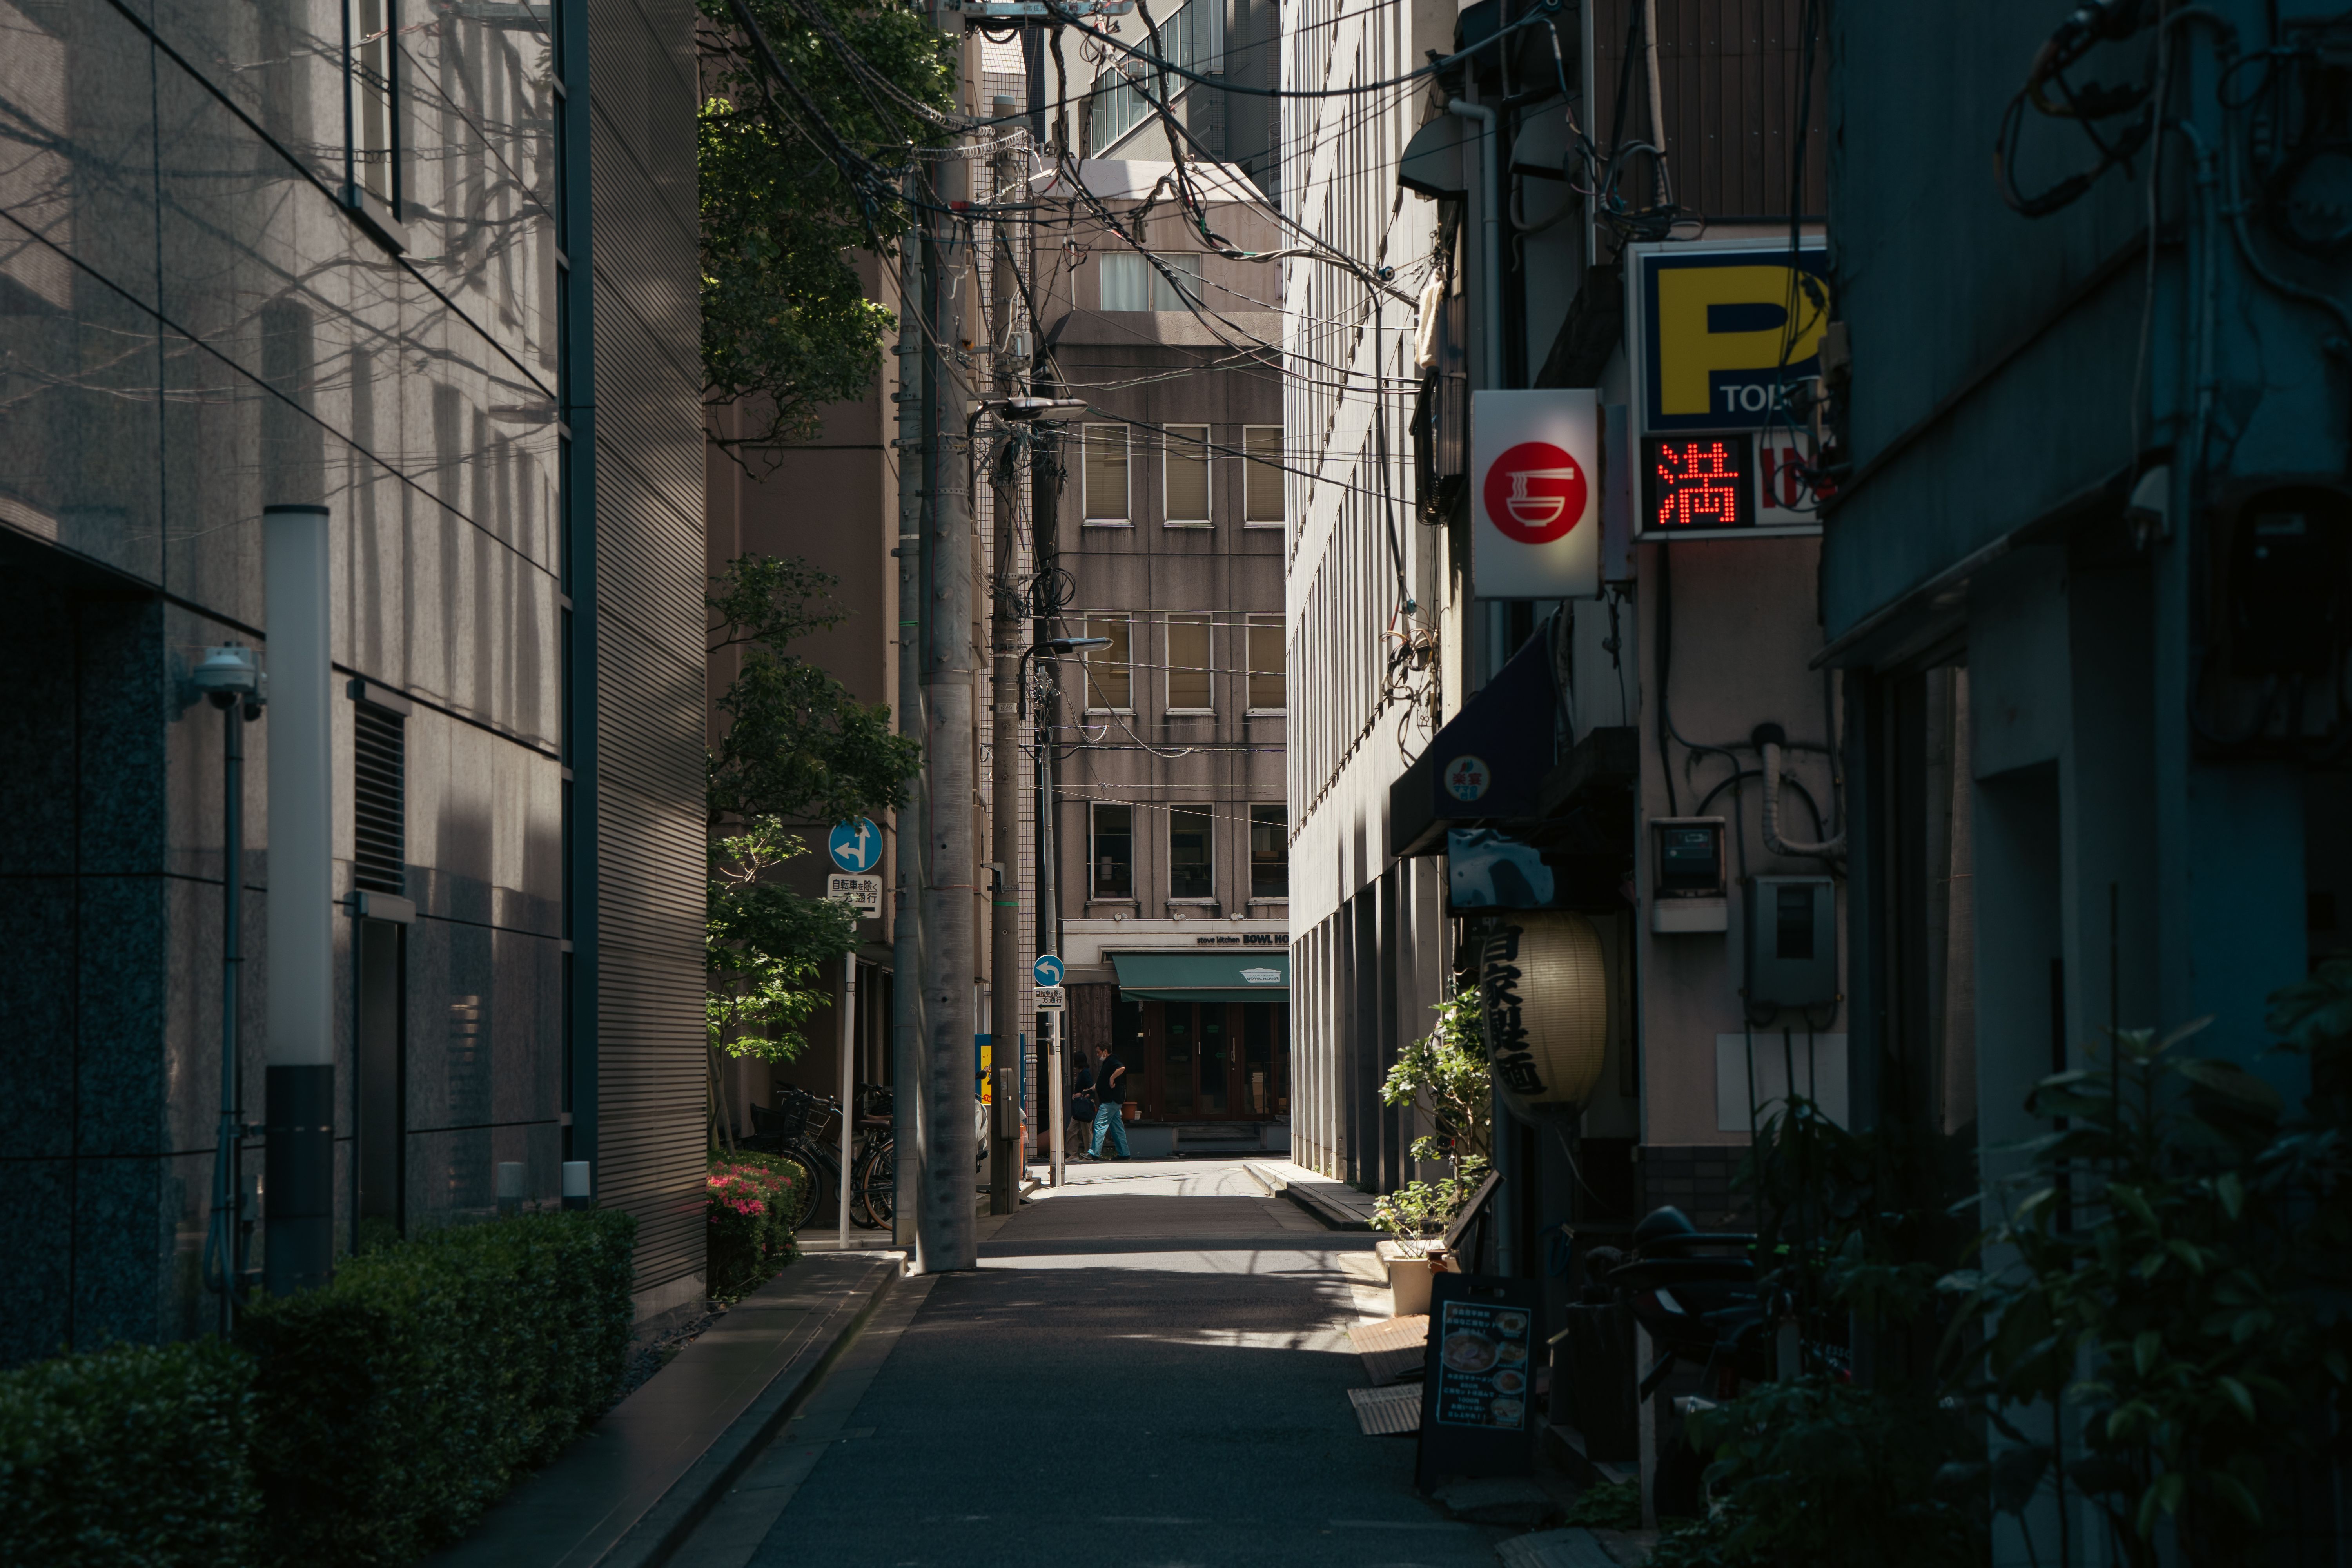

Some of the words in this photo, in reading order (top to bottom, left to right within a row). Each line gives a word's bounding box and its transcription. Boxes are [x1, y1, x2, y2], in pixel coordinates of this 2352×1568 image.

[1657, 265, 1830, 415] P
[1658, 442, 1739, 524] 満
[833, 879, 877, 891] 自転車を除く
[832, 892, 877, 903] 一方通行
[1243, 935, 1273, 943] BOWL
[1275, 935, 1289, 943] HO
